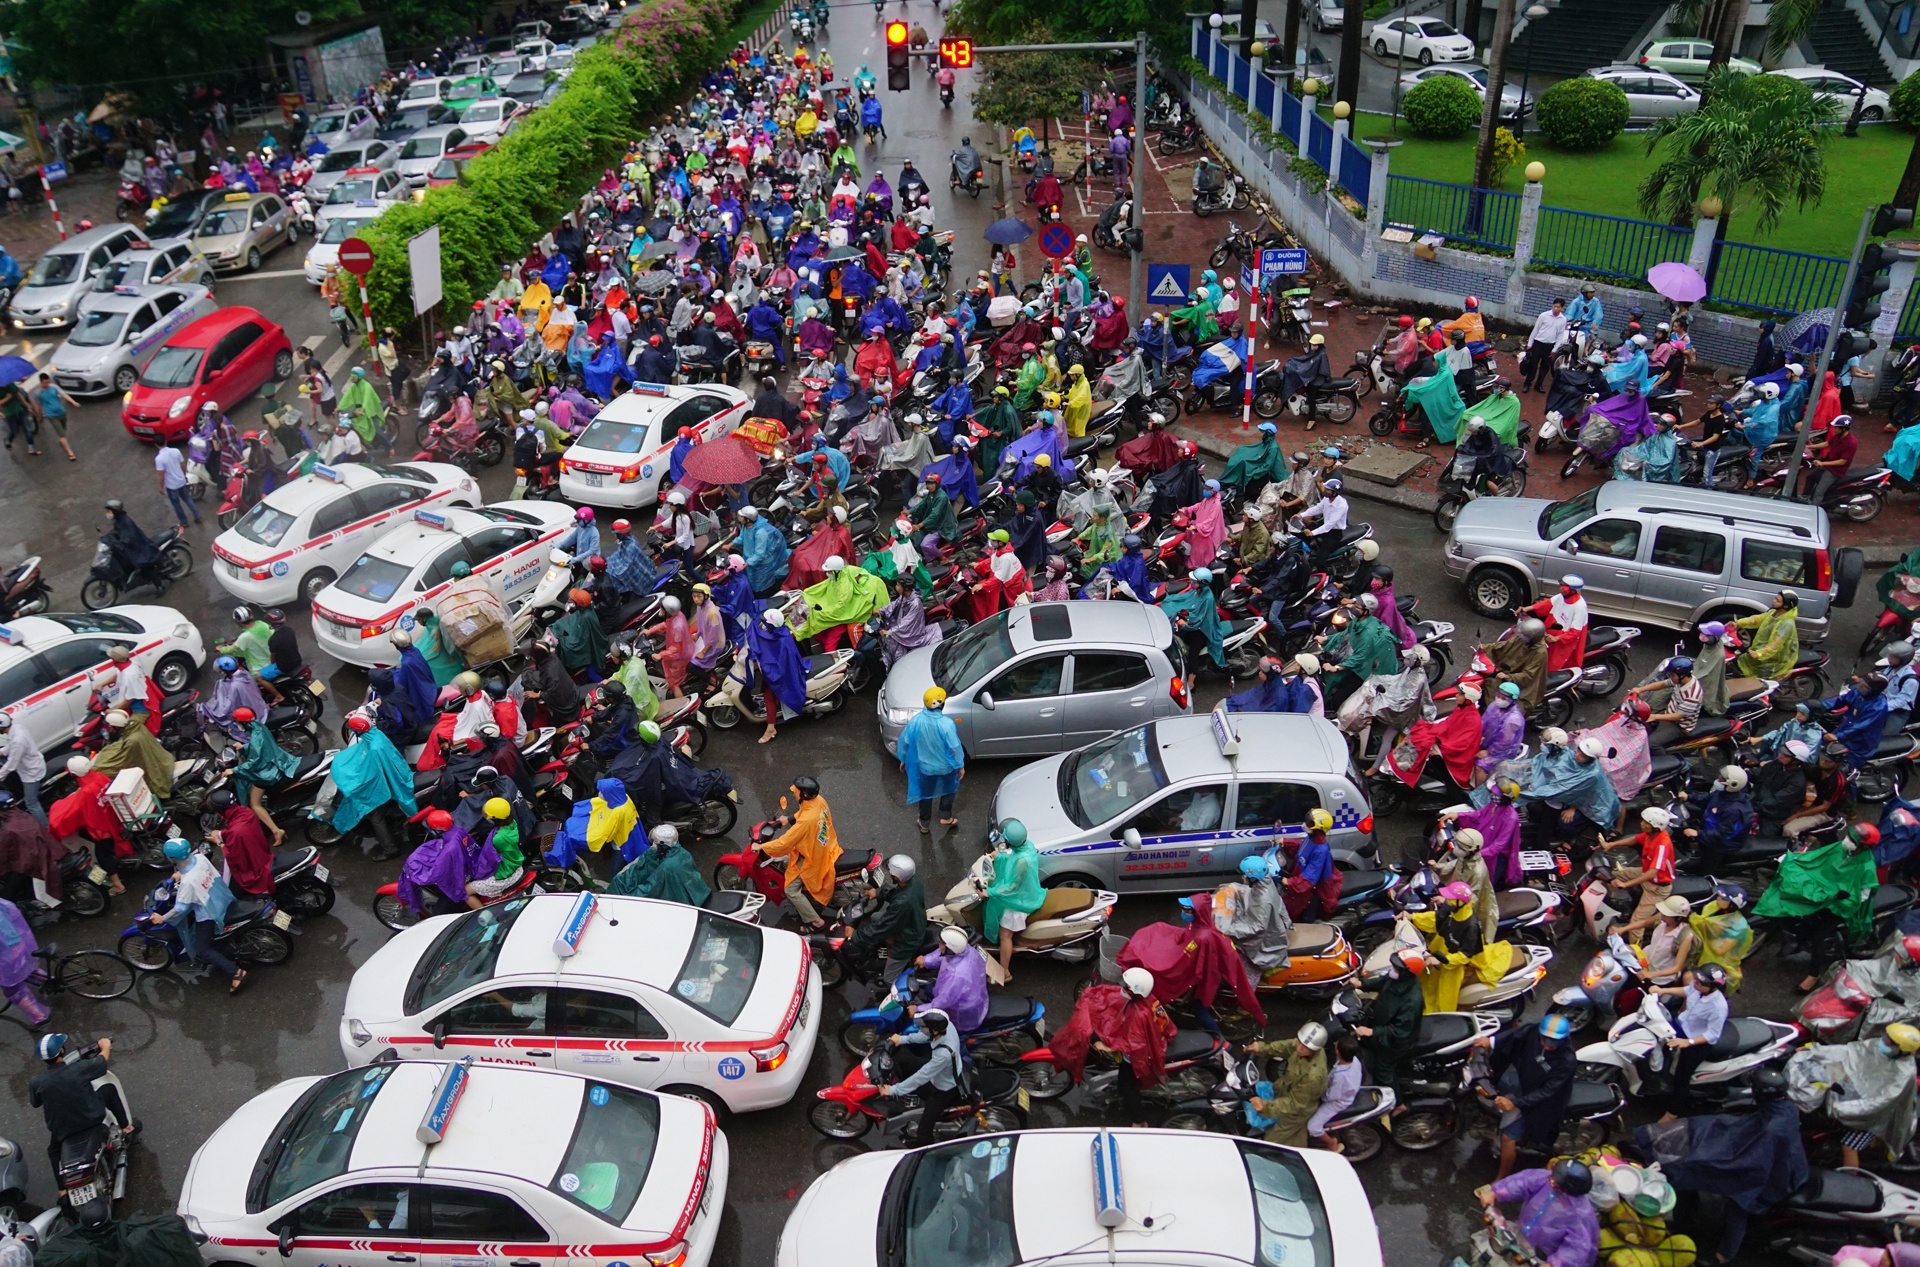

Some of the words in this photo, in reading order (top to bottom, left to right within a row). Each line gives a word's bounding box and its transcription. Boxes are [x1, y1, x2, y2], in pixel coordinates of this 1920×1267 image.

[942, 41, 970, 65] 43
[1284, 260, 1303, 271] HÙNG
[504, 567, 541, 591] 38.53.53.53
[513, 558, 540, 576] HANOI
[1125, 861, 1188, 872] 32.53.53.53
[571, 897, 595, 940] TAXIGROUP
[786, 993, 801, 1023] HANOI
[722, 1065, 741, 1077] 1417
[437, 1069, 465, 1124] TAXIGROUP
[684, 1178, 702, 1217] HANOI
